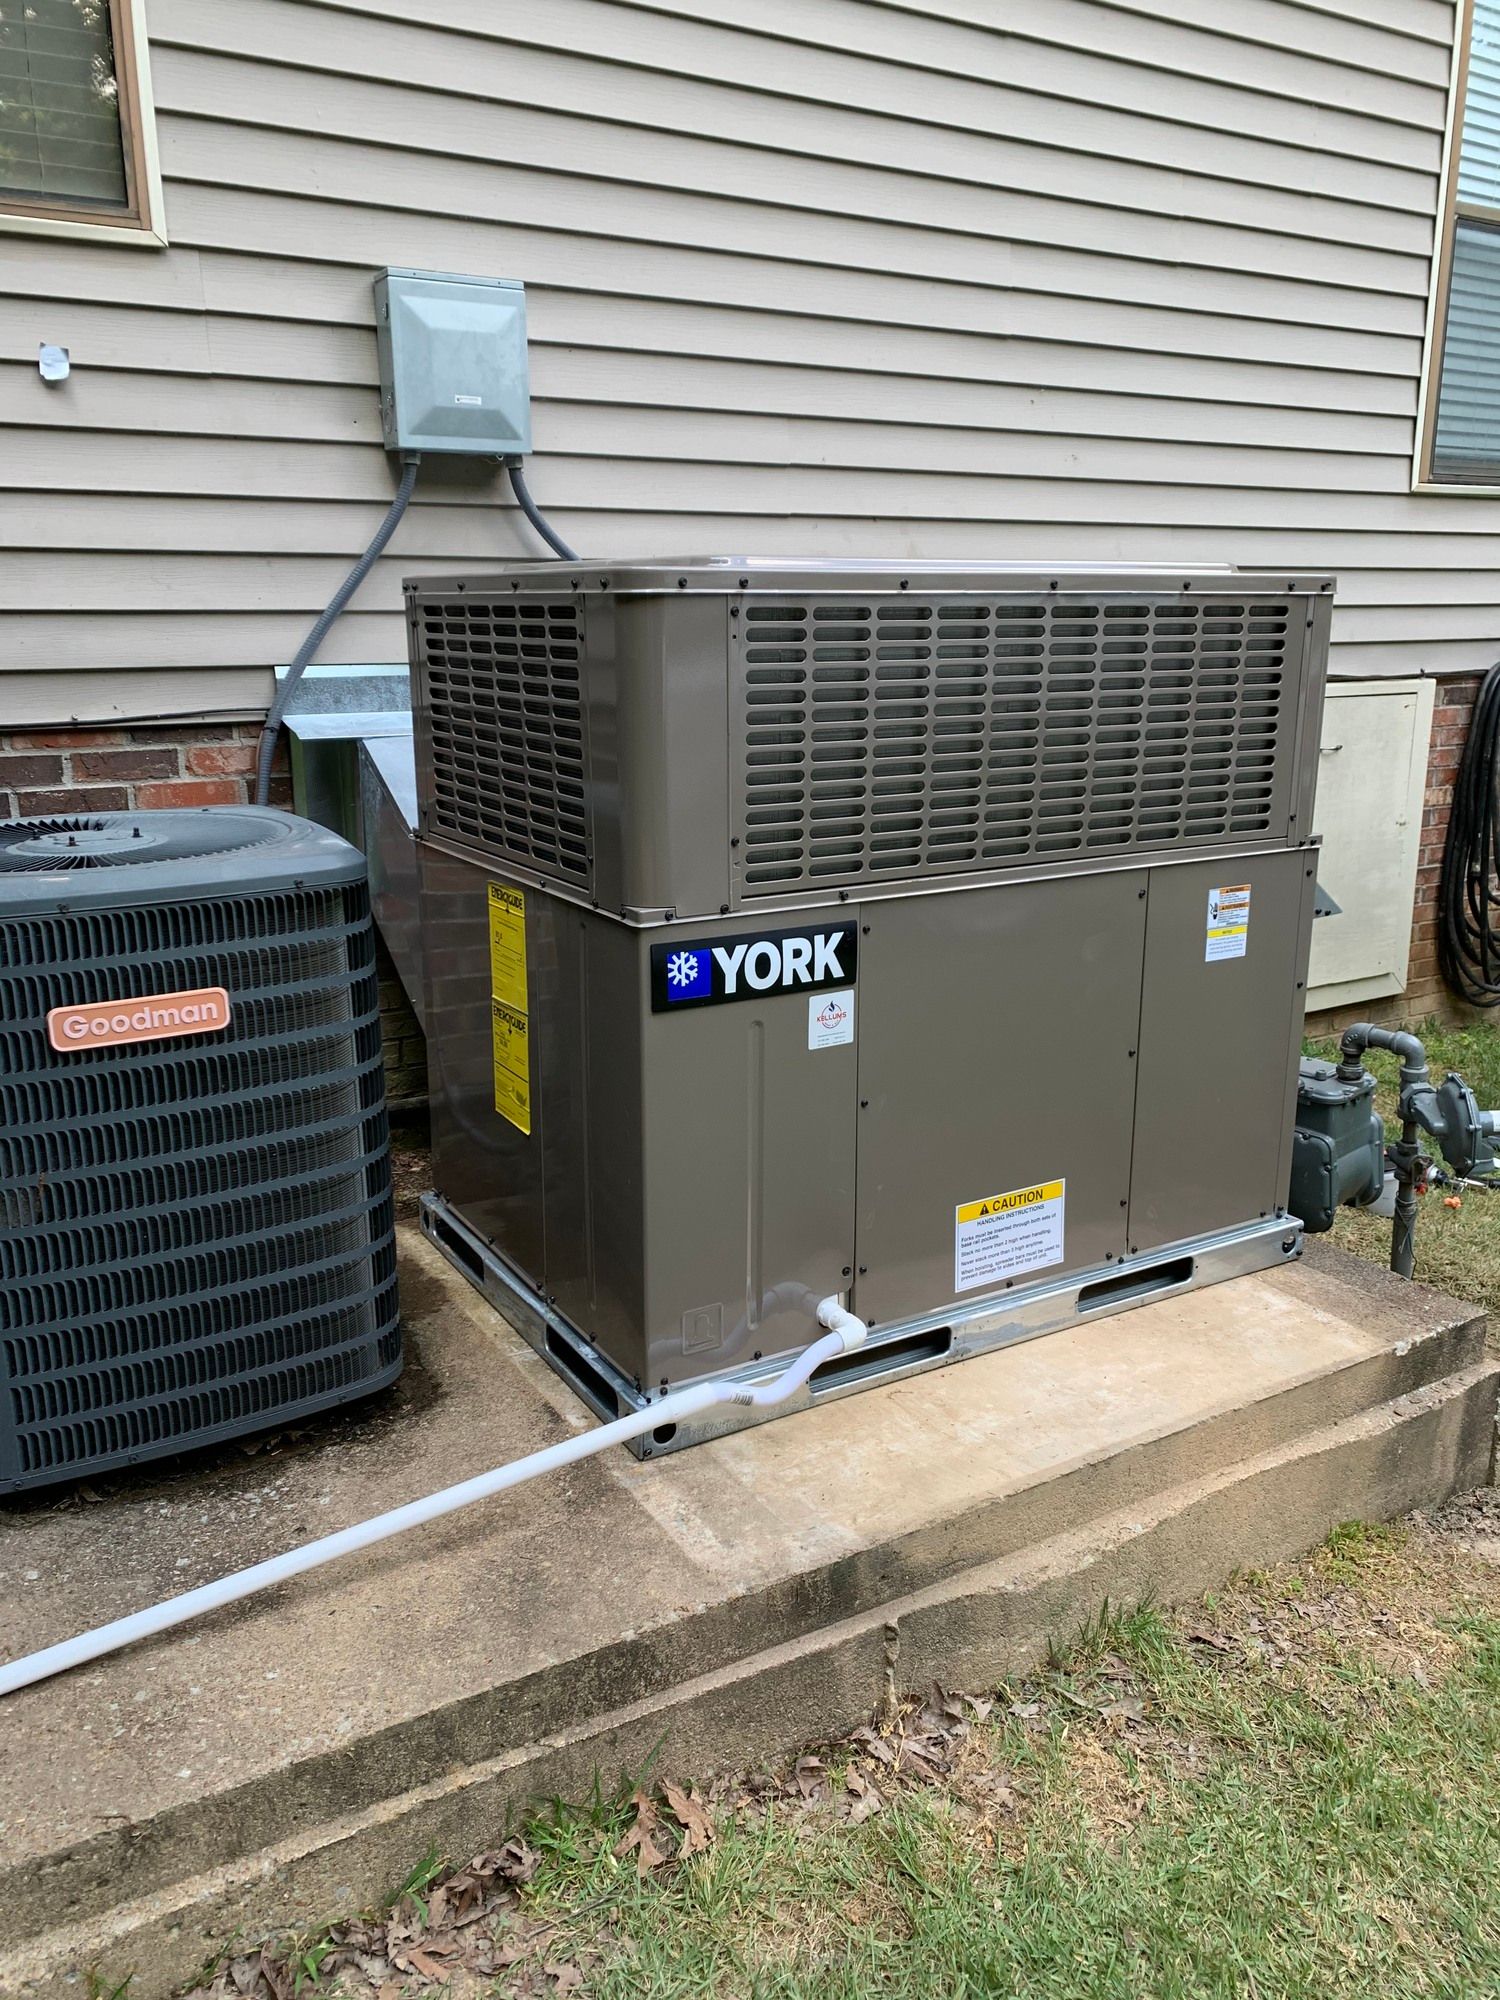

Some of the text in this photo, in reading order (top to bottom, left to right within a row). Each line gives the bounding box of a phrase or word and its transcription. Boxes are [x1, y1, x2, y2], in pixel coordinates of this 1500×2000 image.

[711, 931, 845, 994] YORK
[63, 1002, 218, 1039] Goodman
[817, 1011, 847, 1022] KELLUMS
[992, 1189, 1043, 1212] CAUTION
[976, 1204, 1045, 1226] HANDLING INSTRUCTIONS
[994, 1225, 1012, 1233] inserted
[1013, 1220, 1030, 1229] through
[961, 1272, 978, 1282] prevent
[979, 1267, 996, 1276] damage
[1003, 1261, 1015, 1269] sides
[995, 1256, 1014, 1266] spreader
